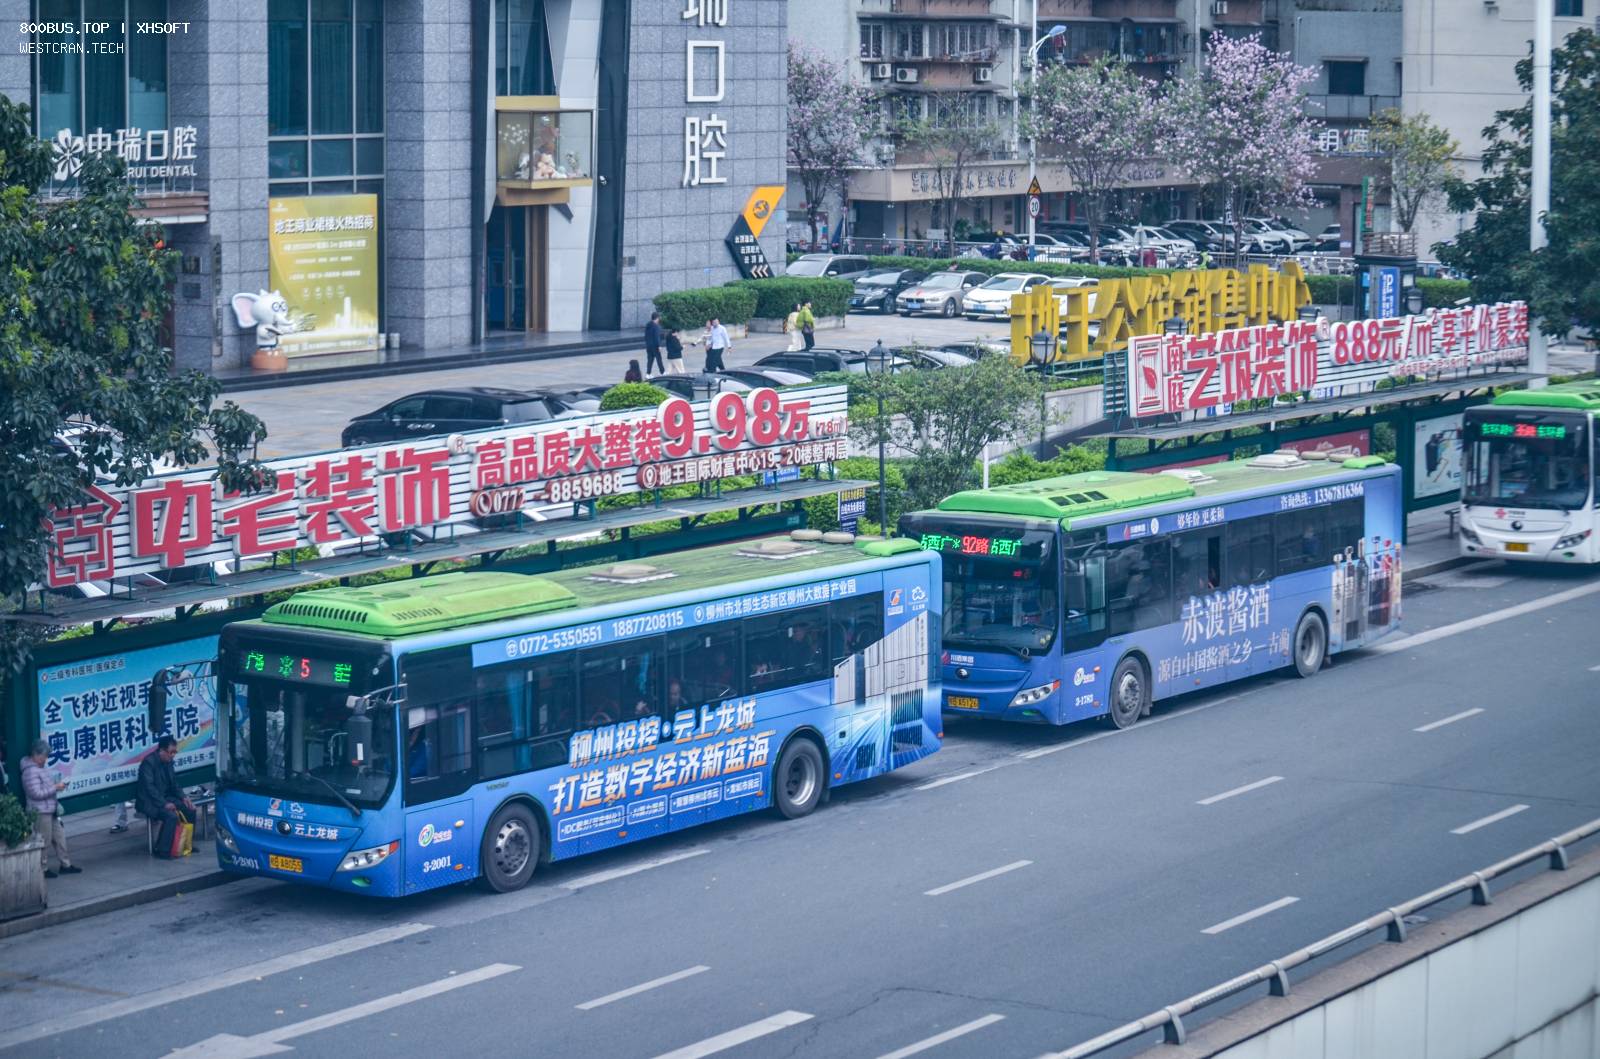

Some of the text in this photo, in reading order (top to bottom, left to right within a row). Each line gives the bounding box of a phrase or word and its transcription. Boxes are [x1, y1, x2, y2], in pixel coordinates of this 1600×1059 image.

[88, 125, 197, 161] 中瑞口腔
[150, 164, 197, 178] DENTAL
[1187, 322, 1318, 410] 艺筑装饰
[1181, 583, 1271, 646] 赤渡酱酒
[519, 611, 684, 655] 0772-5350551 18877208115
[301, 658, 311, 679] 5
[549, 729, 777, 816] 打造数字经济新蓝海
[294, 823, 339, 841] 云上龙城
[423, 856, 451, 873] 3-2001
